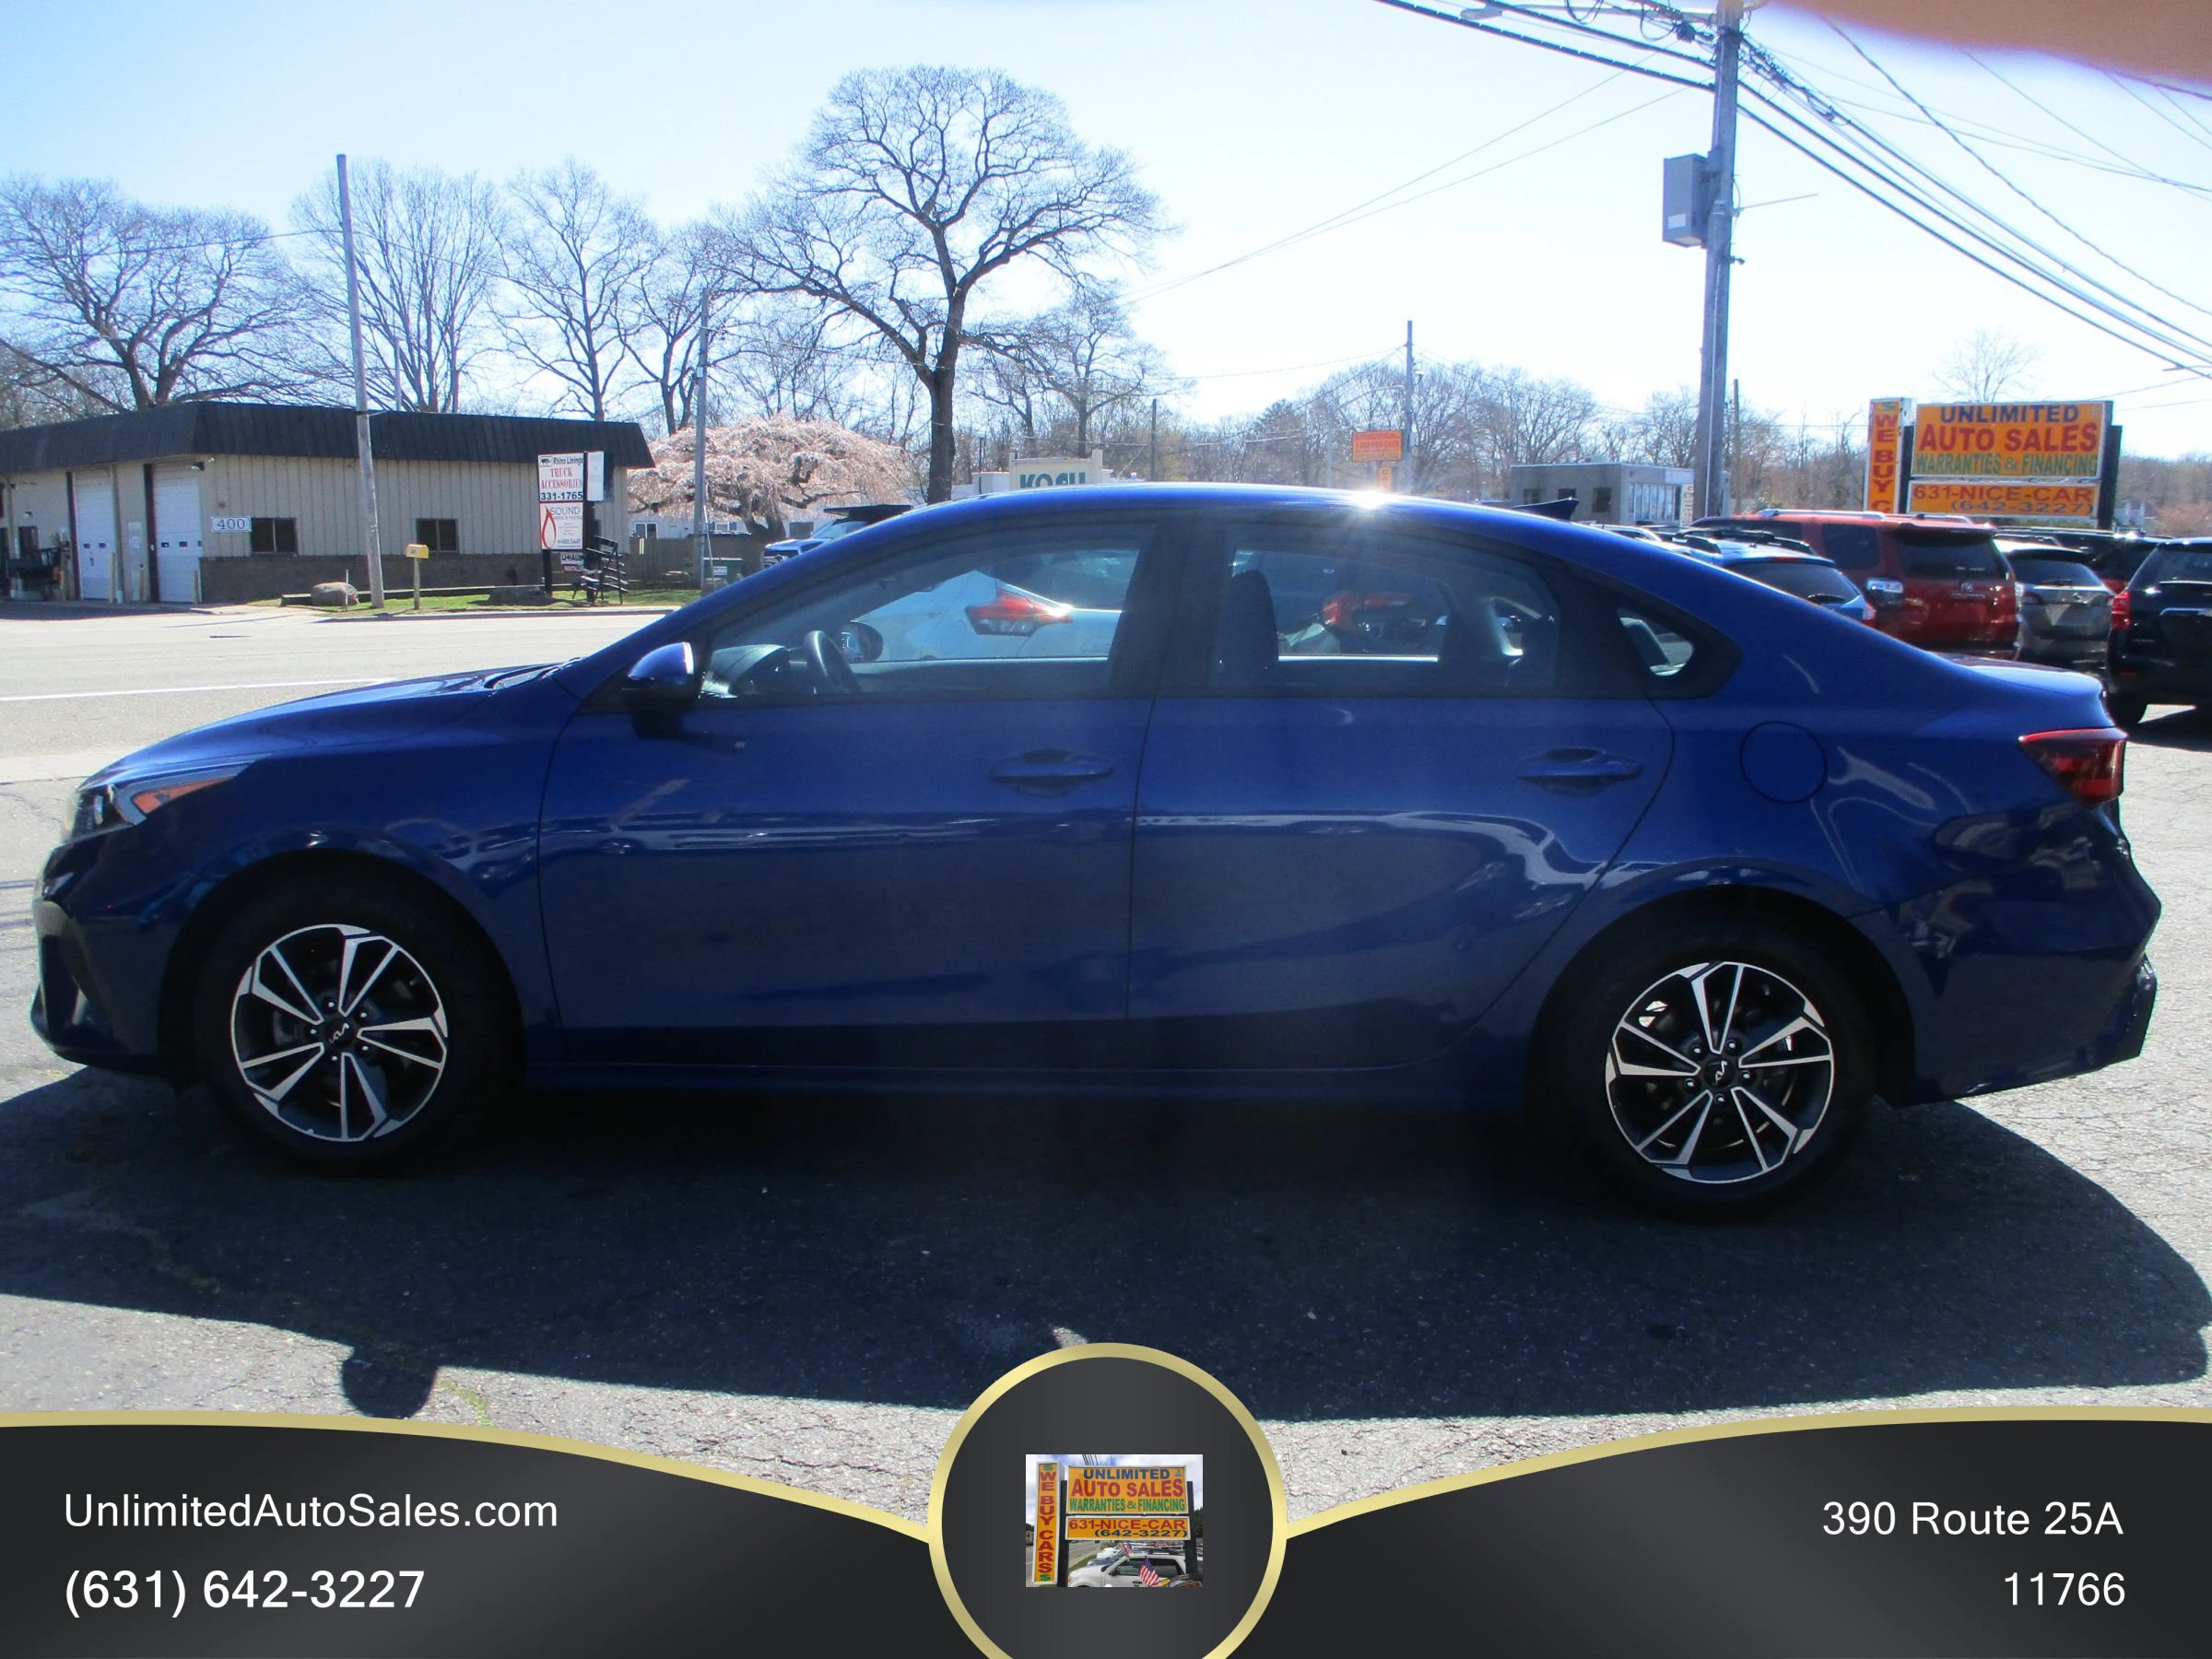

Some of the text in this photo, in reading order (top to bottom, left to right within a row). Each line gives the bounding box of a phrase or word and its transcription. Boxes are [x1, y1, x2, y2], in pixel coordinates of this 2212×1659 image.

[1941, 404, 2078, 422] UNLIMITED
[1875, 414, 1898, 442] WE
[1920, 422, 2097, 452] AUTO SALES
[1872, 450, 1894, 493] BUY
[1915, 453, 2098, 476] WARRANTIES & FINANCING
[550, 468, 573, 478] TRUCK
[541, 479, 583, 489] ACCESSORIES
[541, 491, 582, 501] 331-1765
[1913, 485, 2093, 502] 631-NICE-CAR
[550, 507, 581, 516] SOUND
[1951, 499, 2094, 513] (642-3227)
[217, 518, 245, 529] 400
